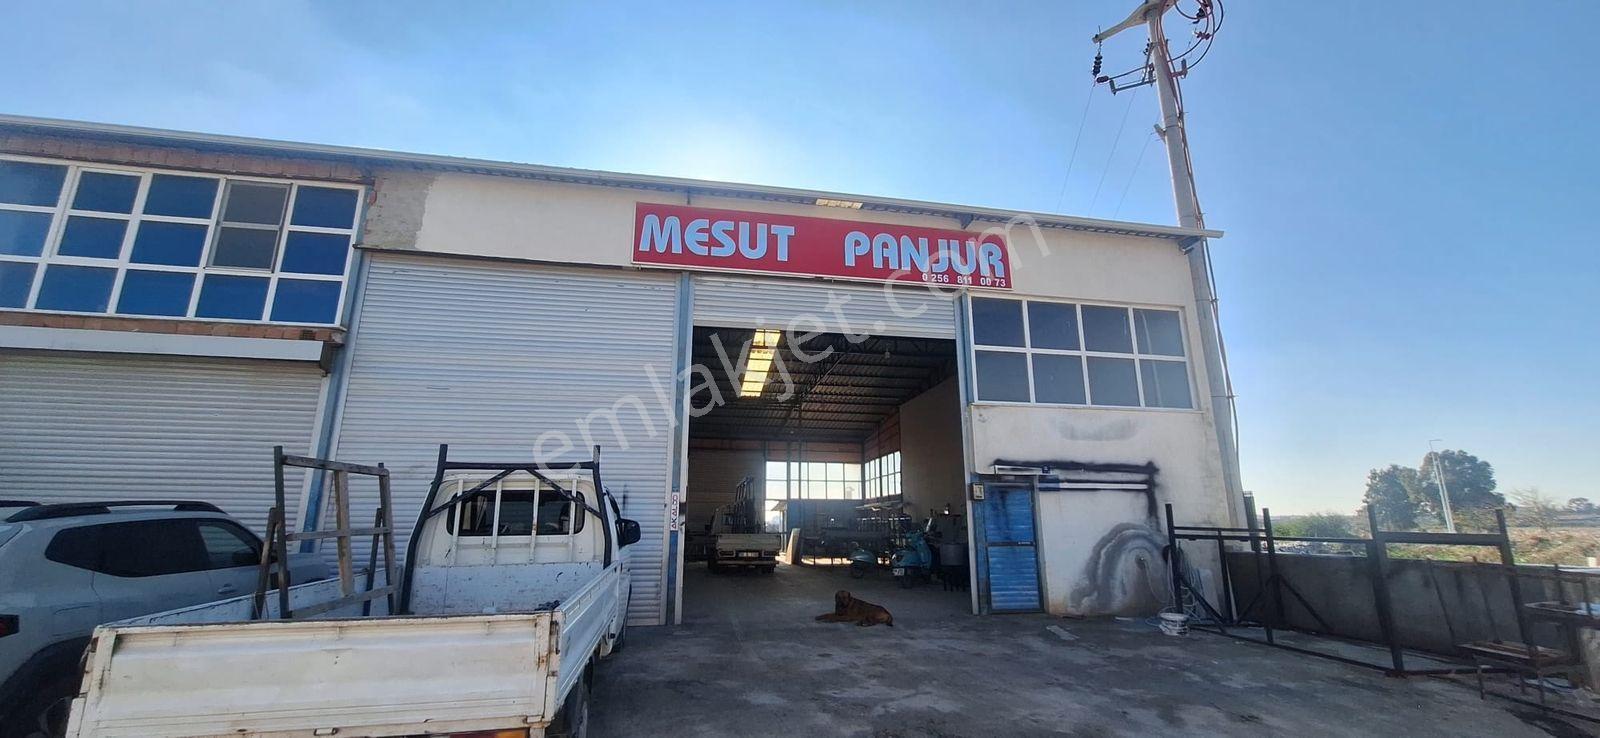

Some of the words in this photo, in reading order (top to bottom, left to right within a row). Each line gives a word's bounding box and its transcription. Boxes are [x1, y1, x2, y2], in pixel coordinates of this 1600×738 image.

[638, 213, 796, 262] MESUT
[843, 230, 1005, 278] PANJUR
[922, 273, 928, 281] 0
[931, 274, 949, 283] 256
[957, 275, 973, 285] 811
[980, 277, 992, 287] 00
[995, 278, 1006, 287] 73
